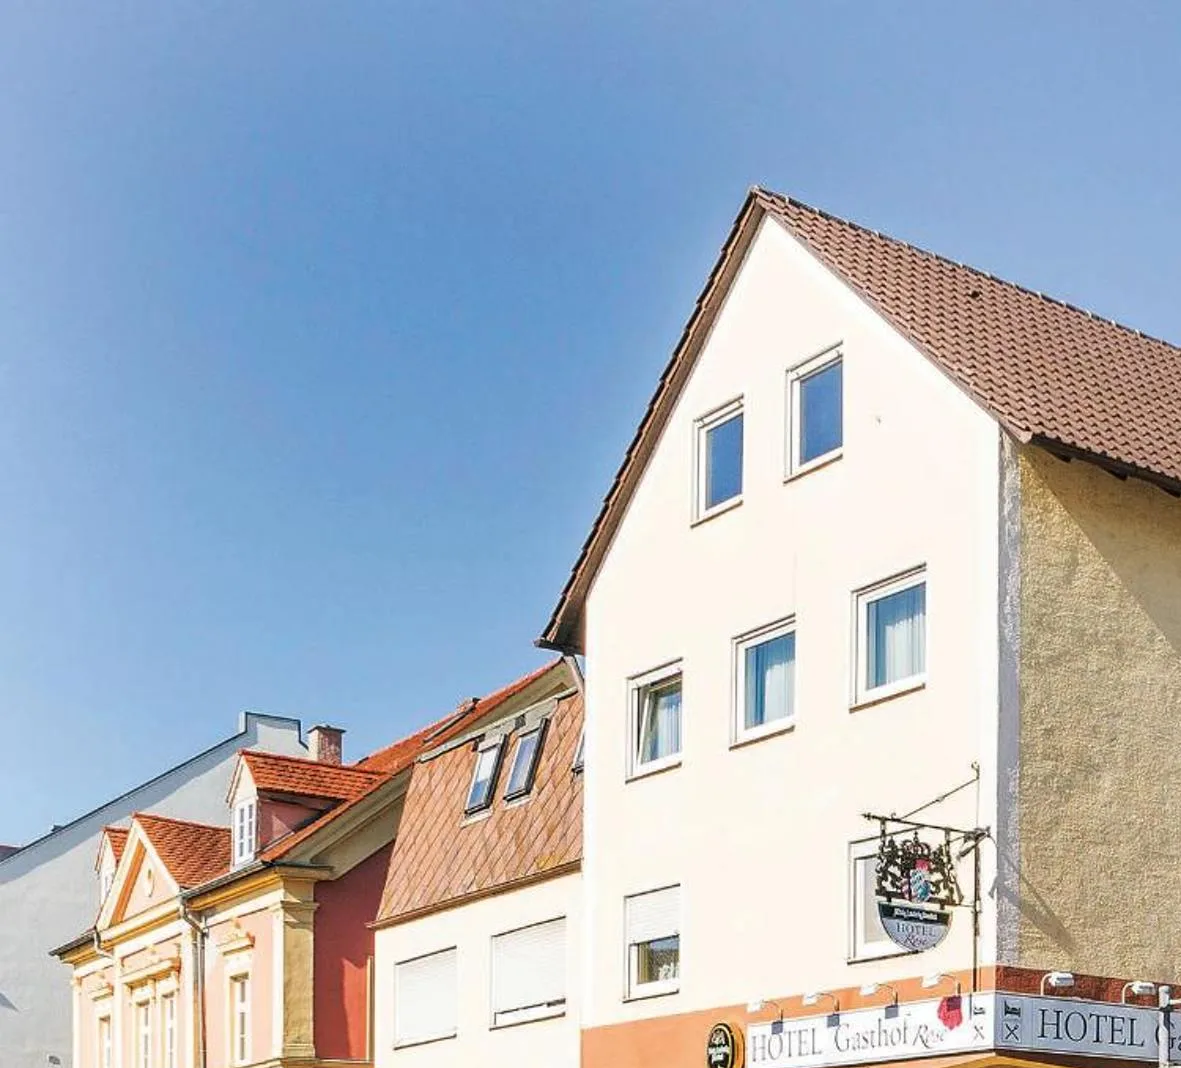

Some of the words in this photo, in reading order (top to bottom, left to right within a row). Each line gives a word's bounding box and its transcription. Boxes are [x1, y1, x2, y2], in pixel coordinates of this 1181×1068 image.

[896, 922, 936, 938] HOTEL
[752, 1027, 823, 1062] HOTEL
[834, 1011, 911, 1052] Gasthof
[1037, 1008, 1145, 1047] HOTEL
